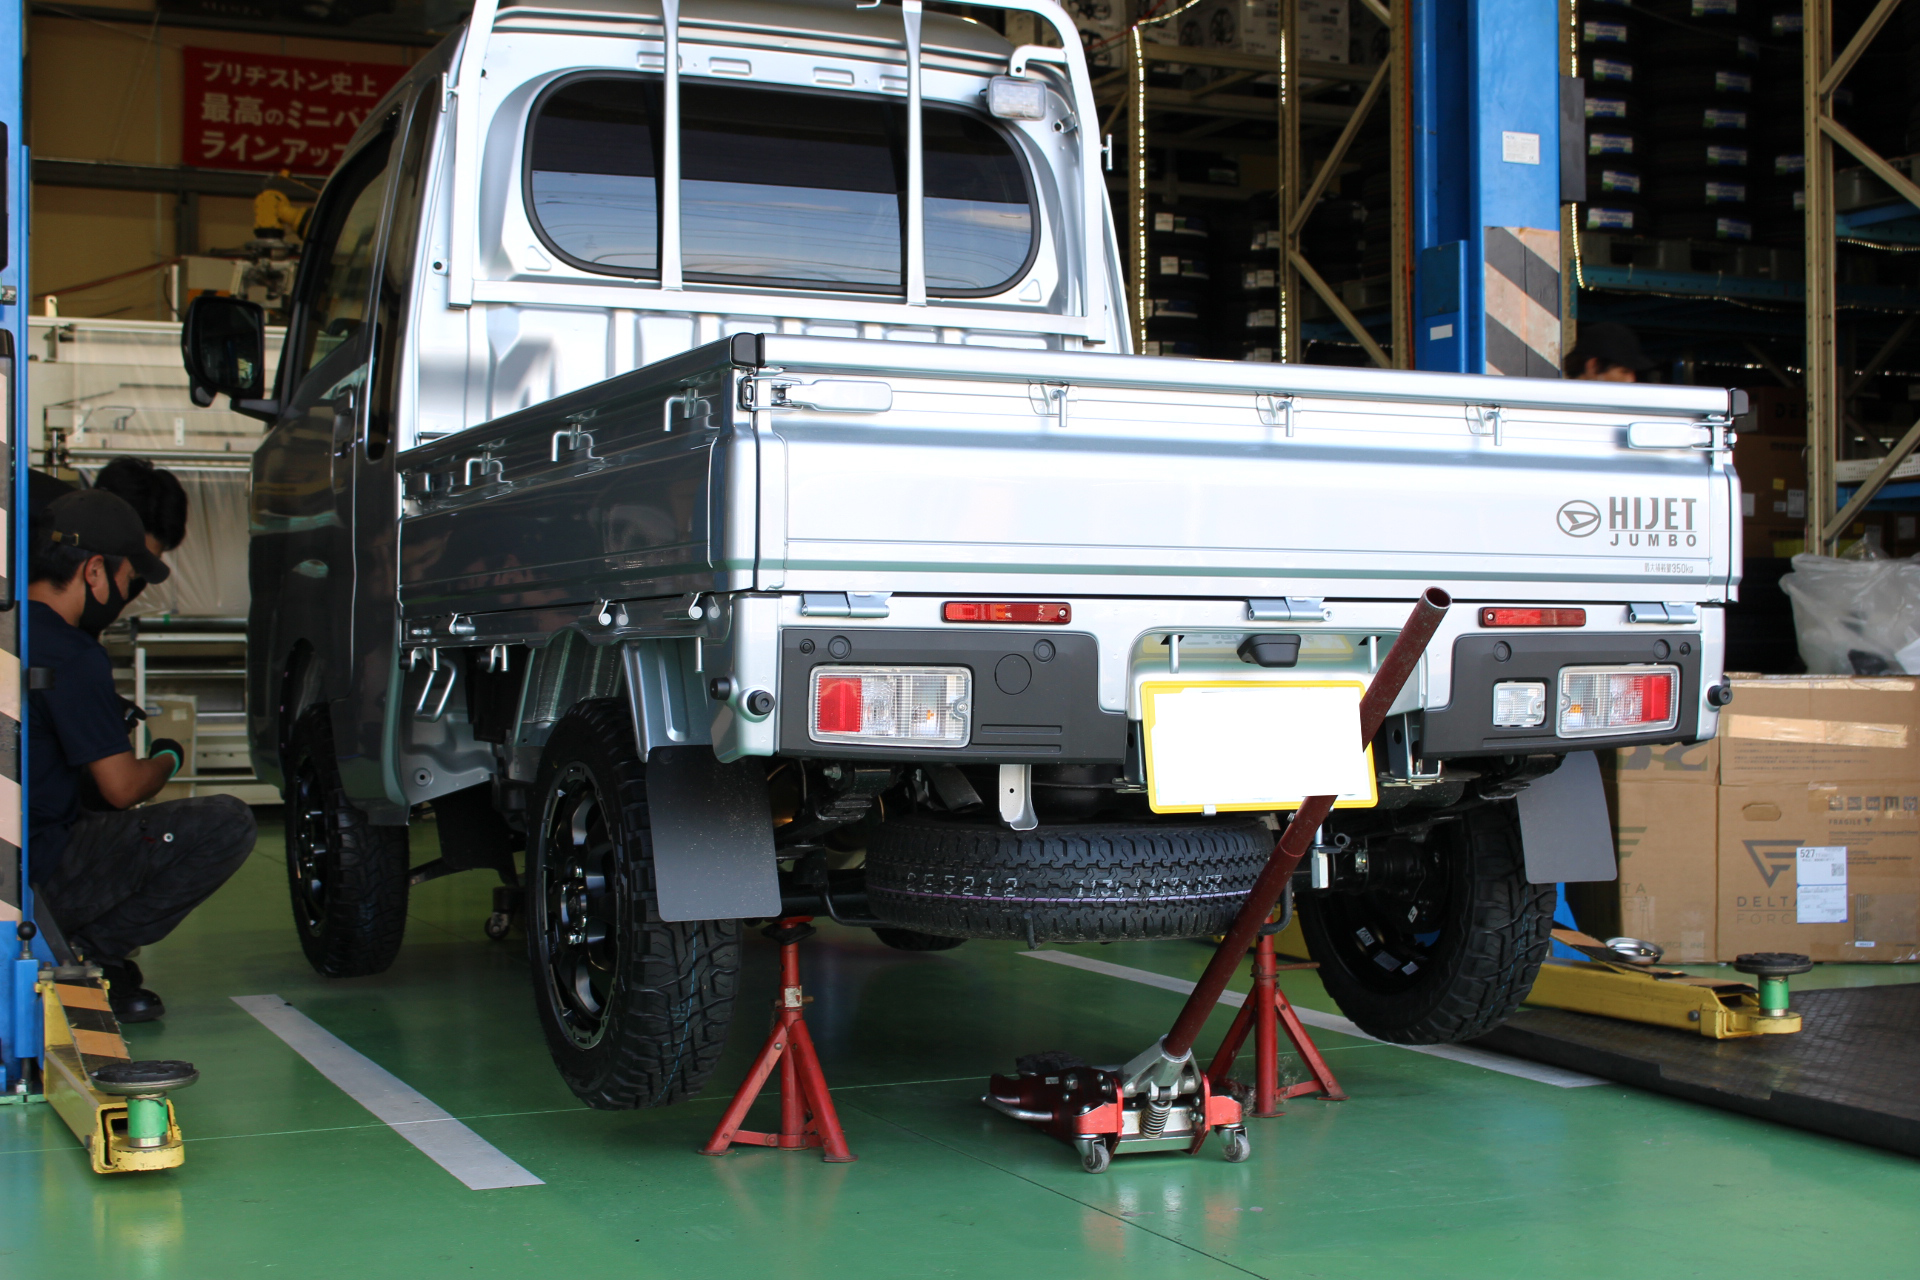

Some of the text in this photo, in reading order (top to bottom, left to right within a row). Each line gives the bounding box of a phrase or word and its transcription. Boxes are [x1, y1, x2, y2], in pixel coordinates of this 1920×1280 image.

[201, 91, 372, 130] 最高のミニバ
[1609, 496, 1697, 531] HIJET
[1610, 533, 1697, 547] JUMBO
[1828, 818, 1862, 826] FRAGILE
[1800, 849, 1815, 858] 527
[1737, 896, 1797, 907] DELT
[1737, 913, 1792, 924] FORC
